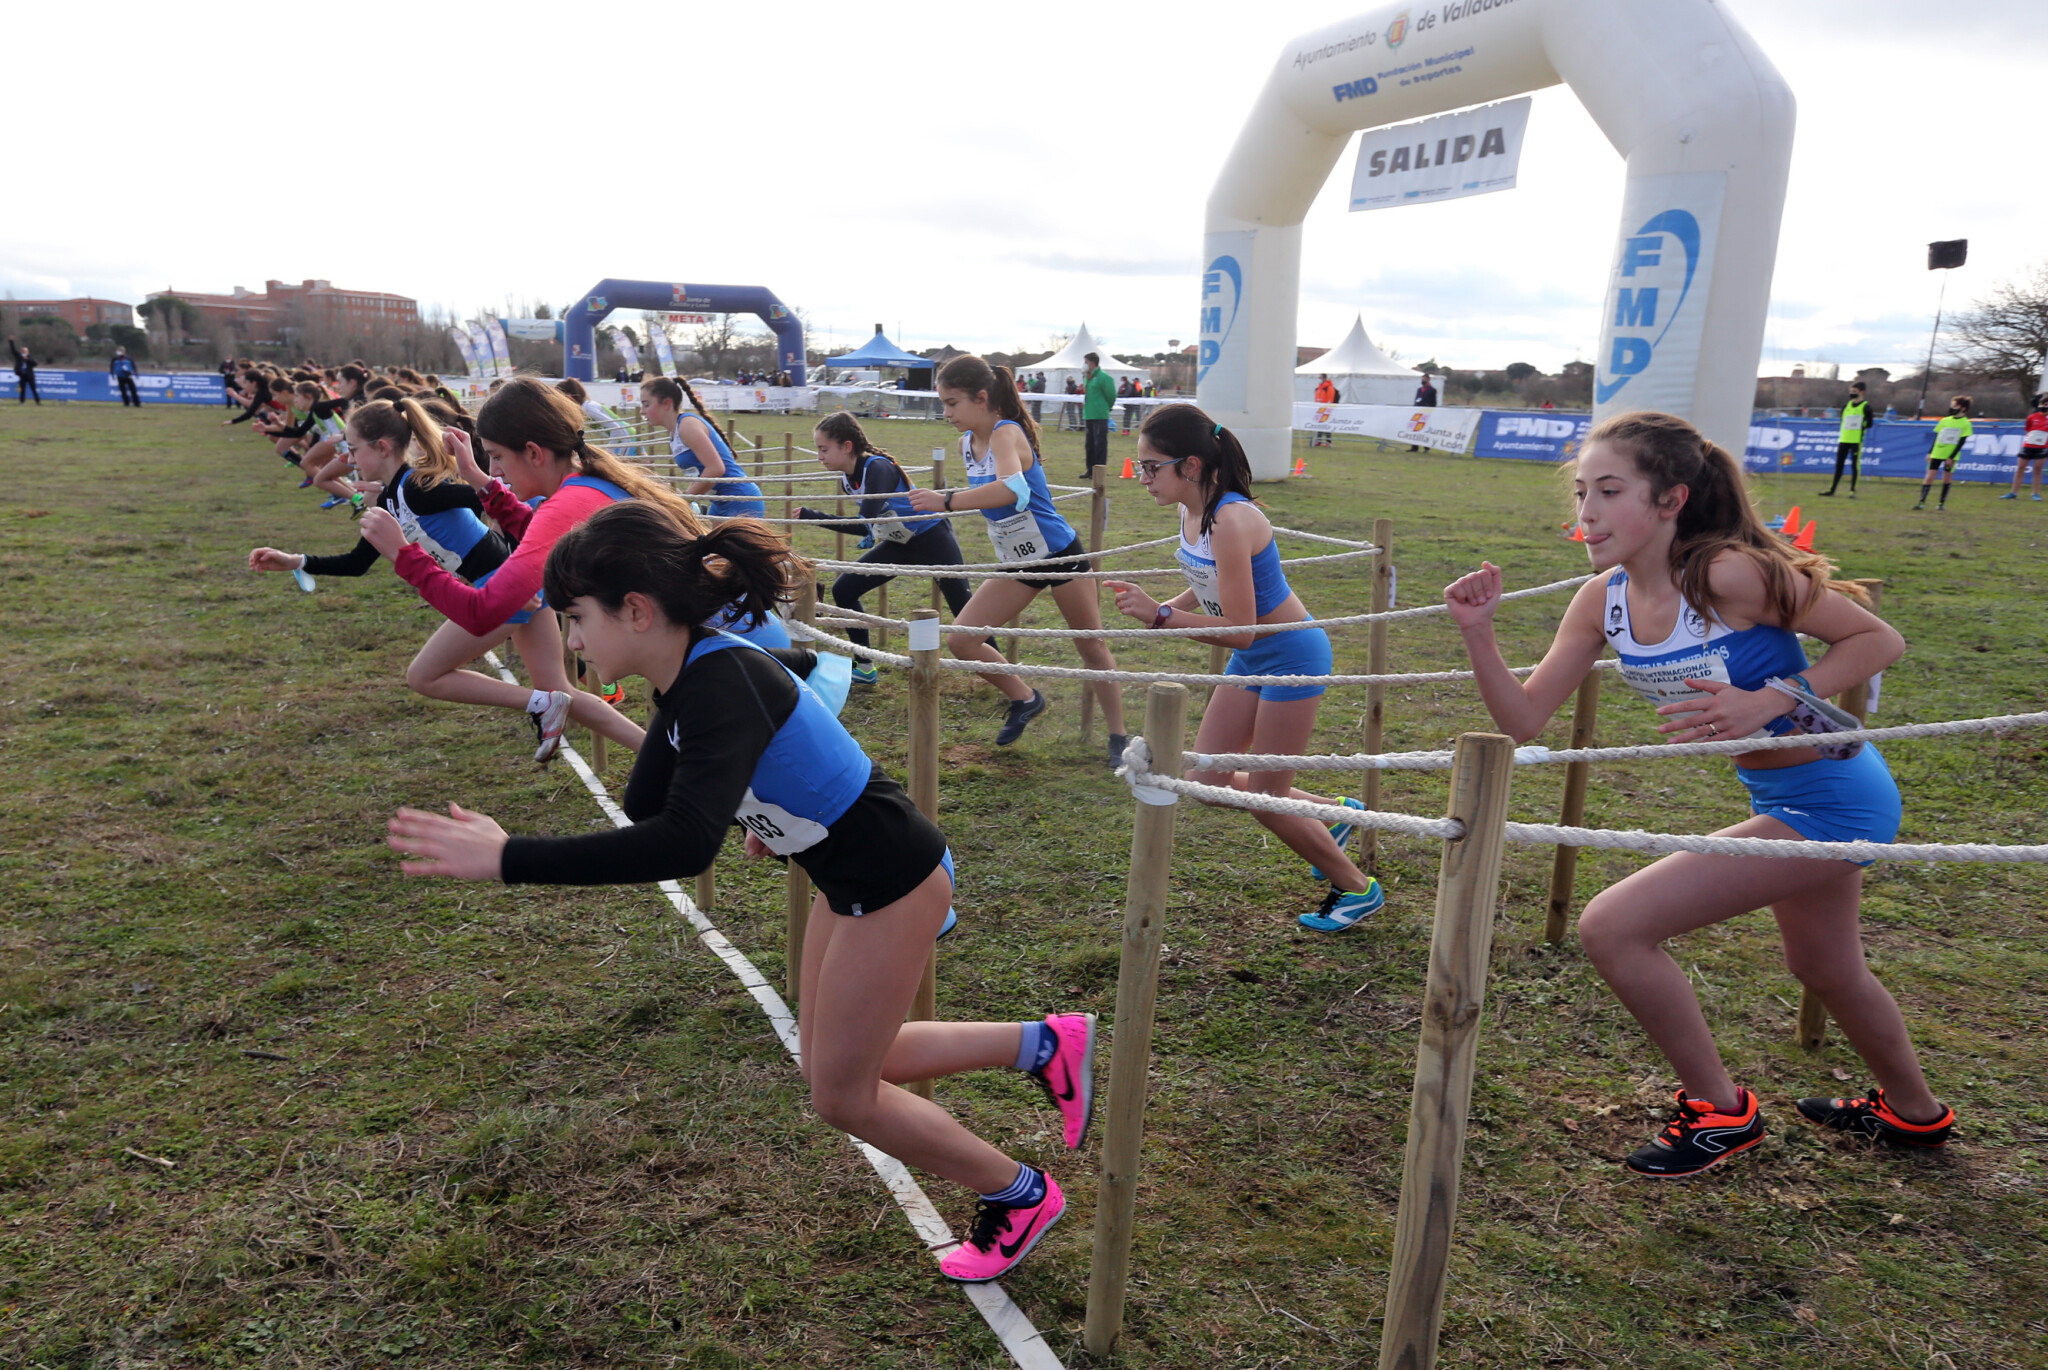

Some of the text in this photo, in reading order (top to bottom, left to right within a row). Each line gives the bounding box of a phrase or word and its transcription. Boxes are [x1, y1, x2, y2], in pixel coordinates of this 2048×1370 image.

[1292, 30, 1377, 70] Ayuntamiento
[1416, 10, 1436, 32] de
[1332, 77, 1379, 103] FMD
[1424, 45, 1476, 67] Municipal
[1368, 127, 1506, 177] SALIDA
[1610, 236, 1664, 375] FMD
[669, 315, 704, 323] META
[1304, 422, 1331, 430] Castilla
[1425, 426, 1467, 440] Junta de
[1495, 417, 1575, 438] FMD
[1397, 430, 1430, 444] Castilla
[1440, 438, 1463, 449] León
[1493, 441, 1556, 451] Ayuntamiento
[1961, 434, 2026, 456] FM
[1804, 457, 1820, 465] de
[1013, 541, 1036, 558] 188
[1646, 663, 1711, 678] INTERNACIONAL
[1650, 669, 1712, 683] VALLADOLID
[738, 813, 785, 839] 193
